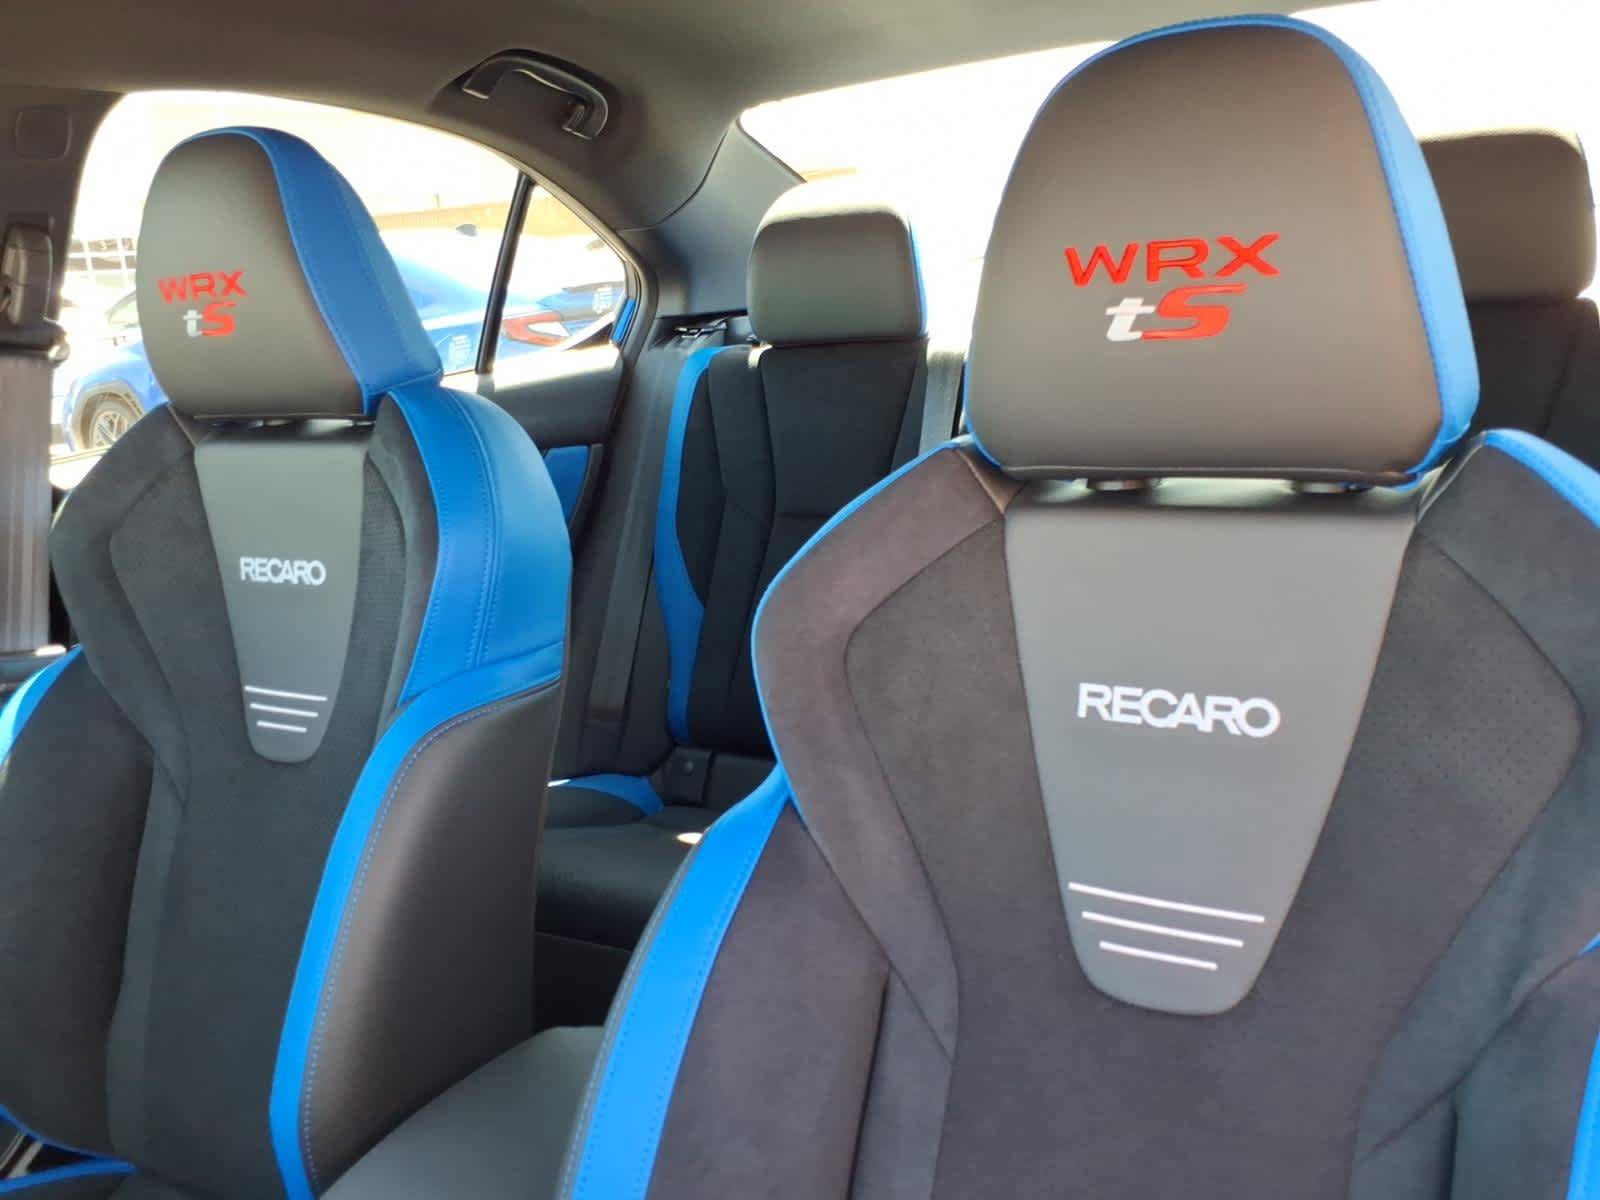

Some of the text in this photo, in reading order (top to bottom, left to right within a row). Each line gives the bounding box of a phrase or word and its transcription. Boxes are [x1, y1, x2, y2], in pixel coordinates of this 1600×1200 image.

[1063, 232, 1281, 288] WRX
[158, 270, 248, 304] WRX
[183, 300, 237, 339] tS
[1105, 282, 1248, 343] tS
[239, 555, 327, 587] RECARO
[1078, 682, 1281, 738] RECARO
